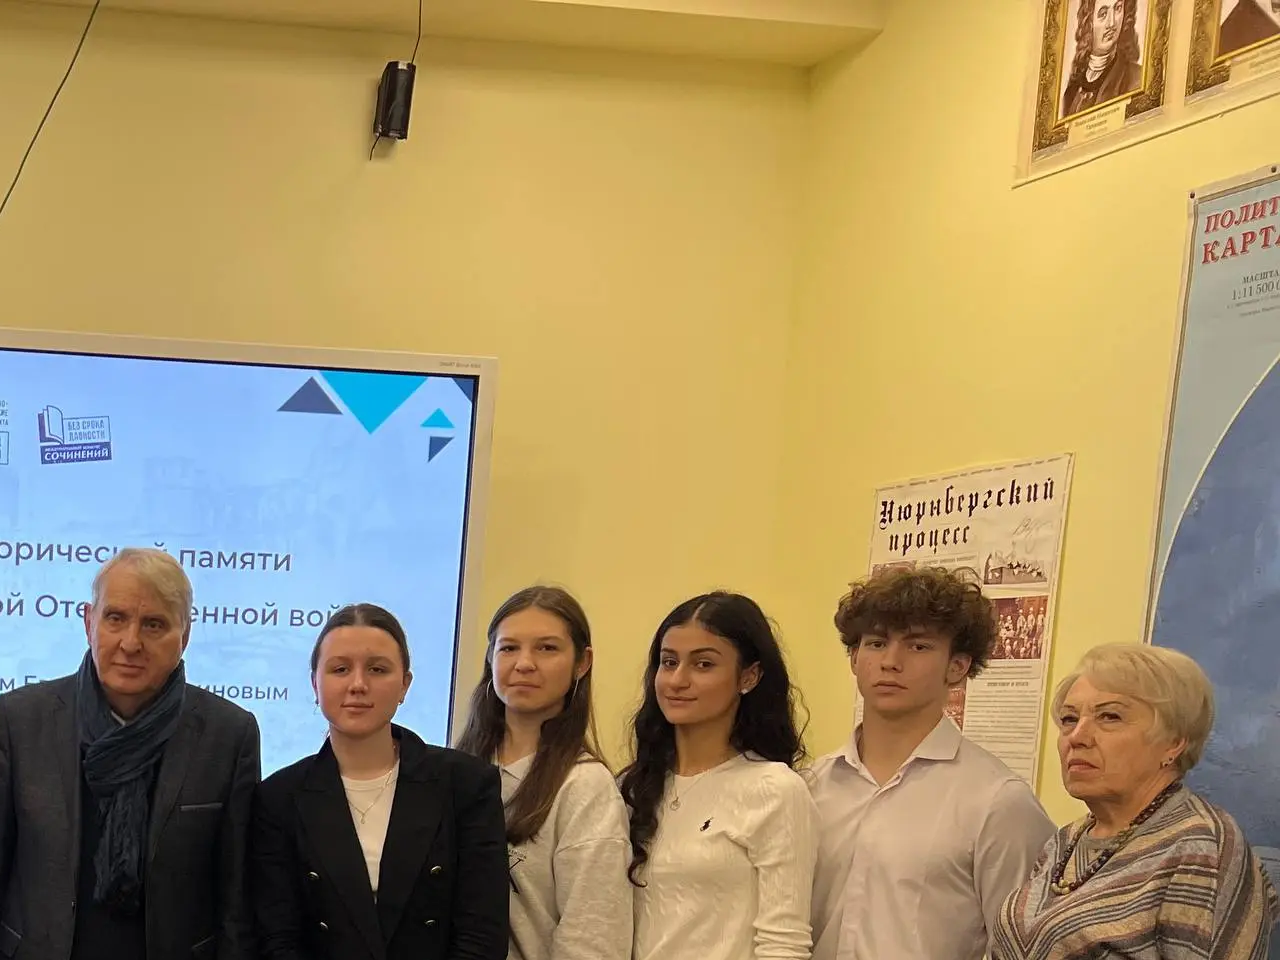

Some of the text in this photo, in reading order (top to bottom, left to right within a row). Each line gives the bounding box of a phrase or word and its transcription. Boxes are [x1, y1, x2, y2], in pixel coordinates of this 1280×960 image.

[67, 419, 105, 431] БЕЗ СРОКА
[69, 430, 105, 442] ДАВНОСТИ
[44, 448, 109, 461] СОЧИНЕНИЙ
[879, 477, 1055, 530] Нюрнбергский
[888, 525, 970, 556] процесс
[180, 549, 292, 572] памяти
